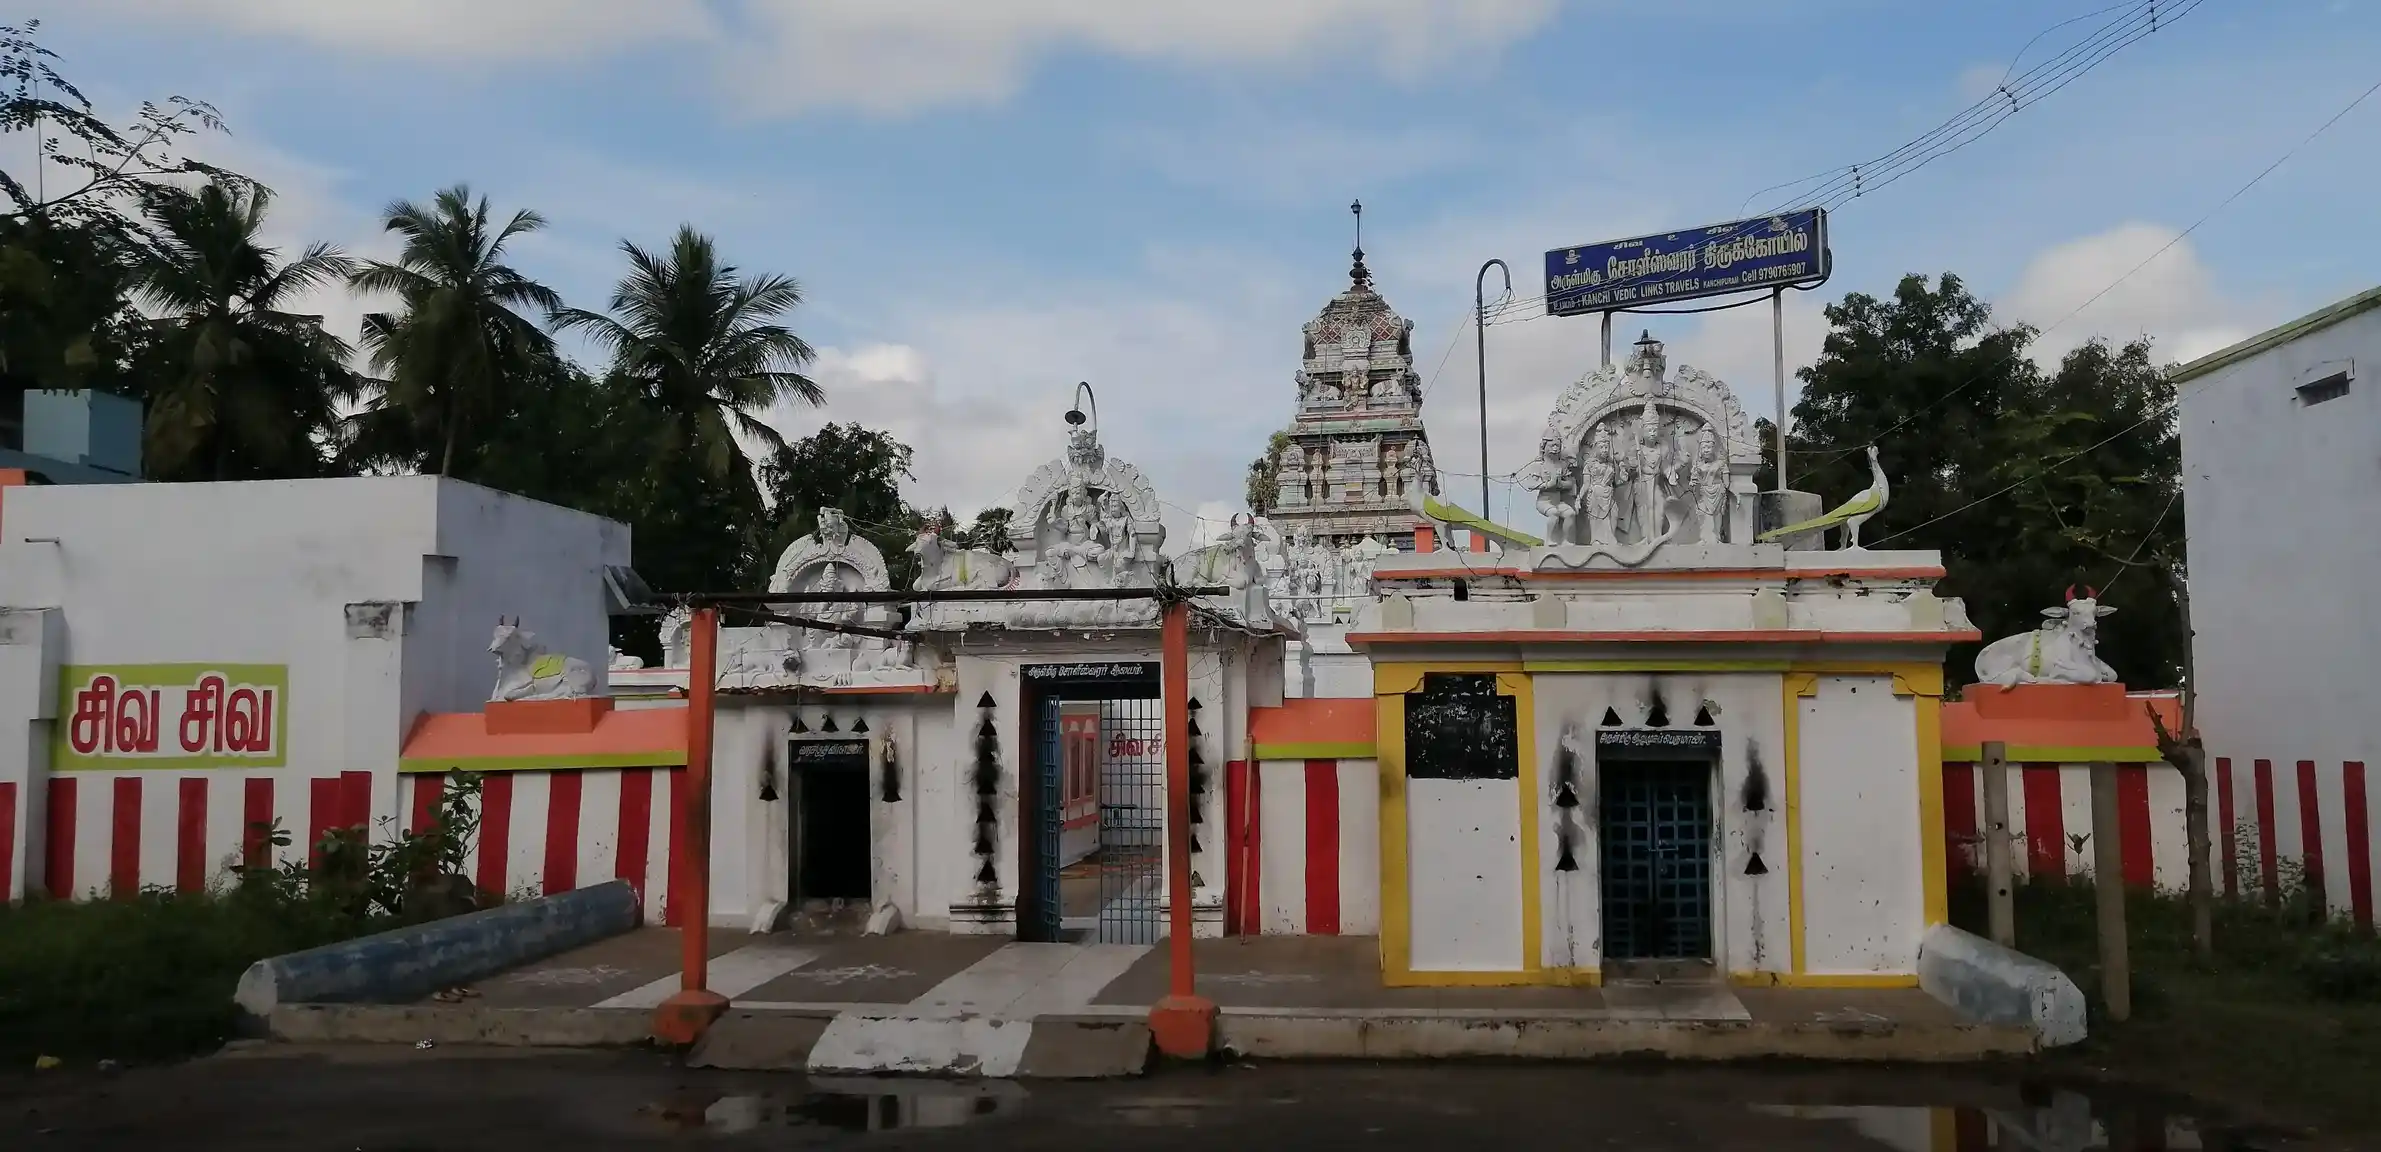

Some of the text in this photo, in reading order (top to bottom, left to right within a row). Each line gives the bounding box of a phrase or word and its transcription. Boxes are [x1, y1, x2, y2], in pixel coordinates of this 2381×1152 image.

[1550, 267, 1601, 290] அருள்மிகு
[1703, 226, 1808, 273] திருக்கோயில்
[1582, 290, 1611, 307] KANCHI
[1614, 288, 1637, 302] VEDIC
[1640, 284, 1664, 298] LINKS
[1665, 278, 1699, 294] TRAVELS
[1703, 276, 1739, 289] KANCHIPURAM
[1742, 270, 1757, 283] Cell
[71, 675, 273, 754] சிவ சிவ
